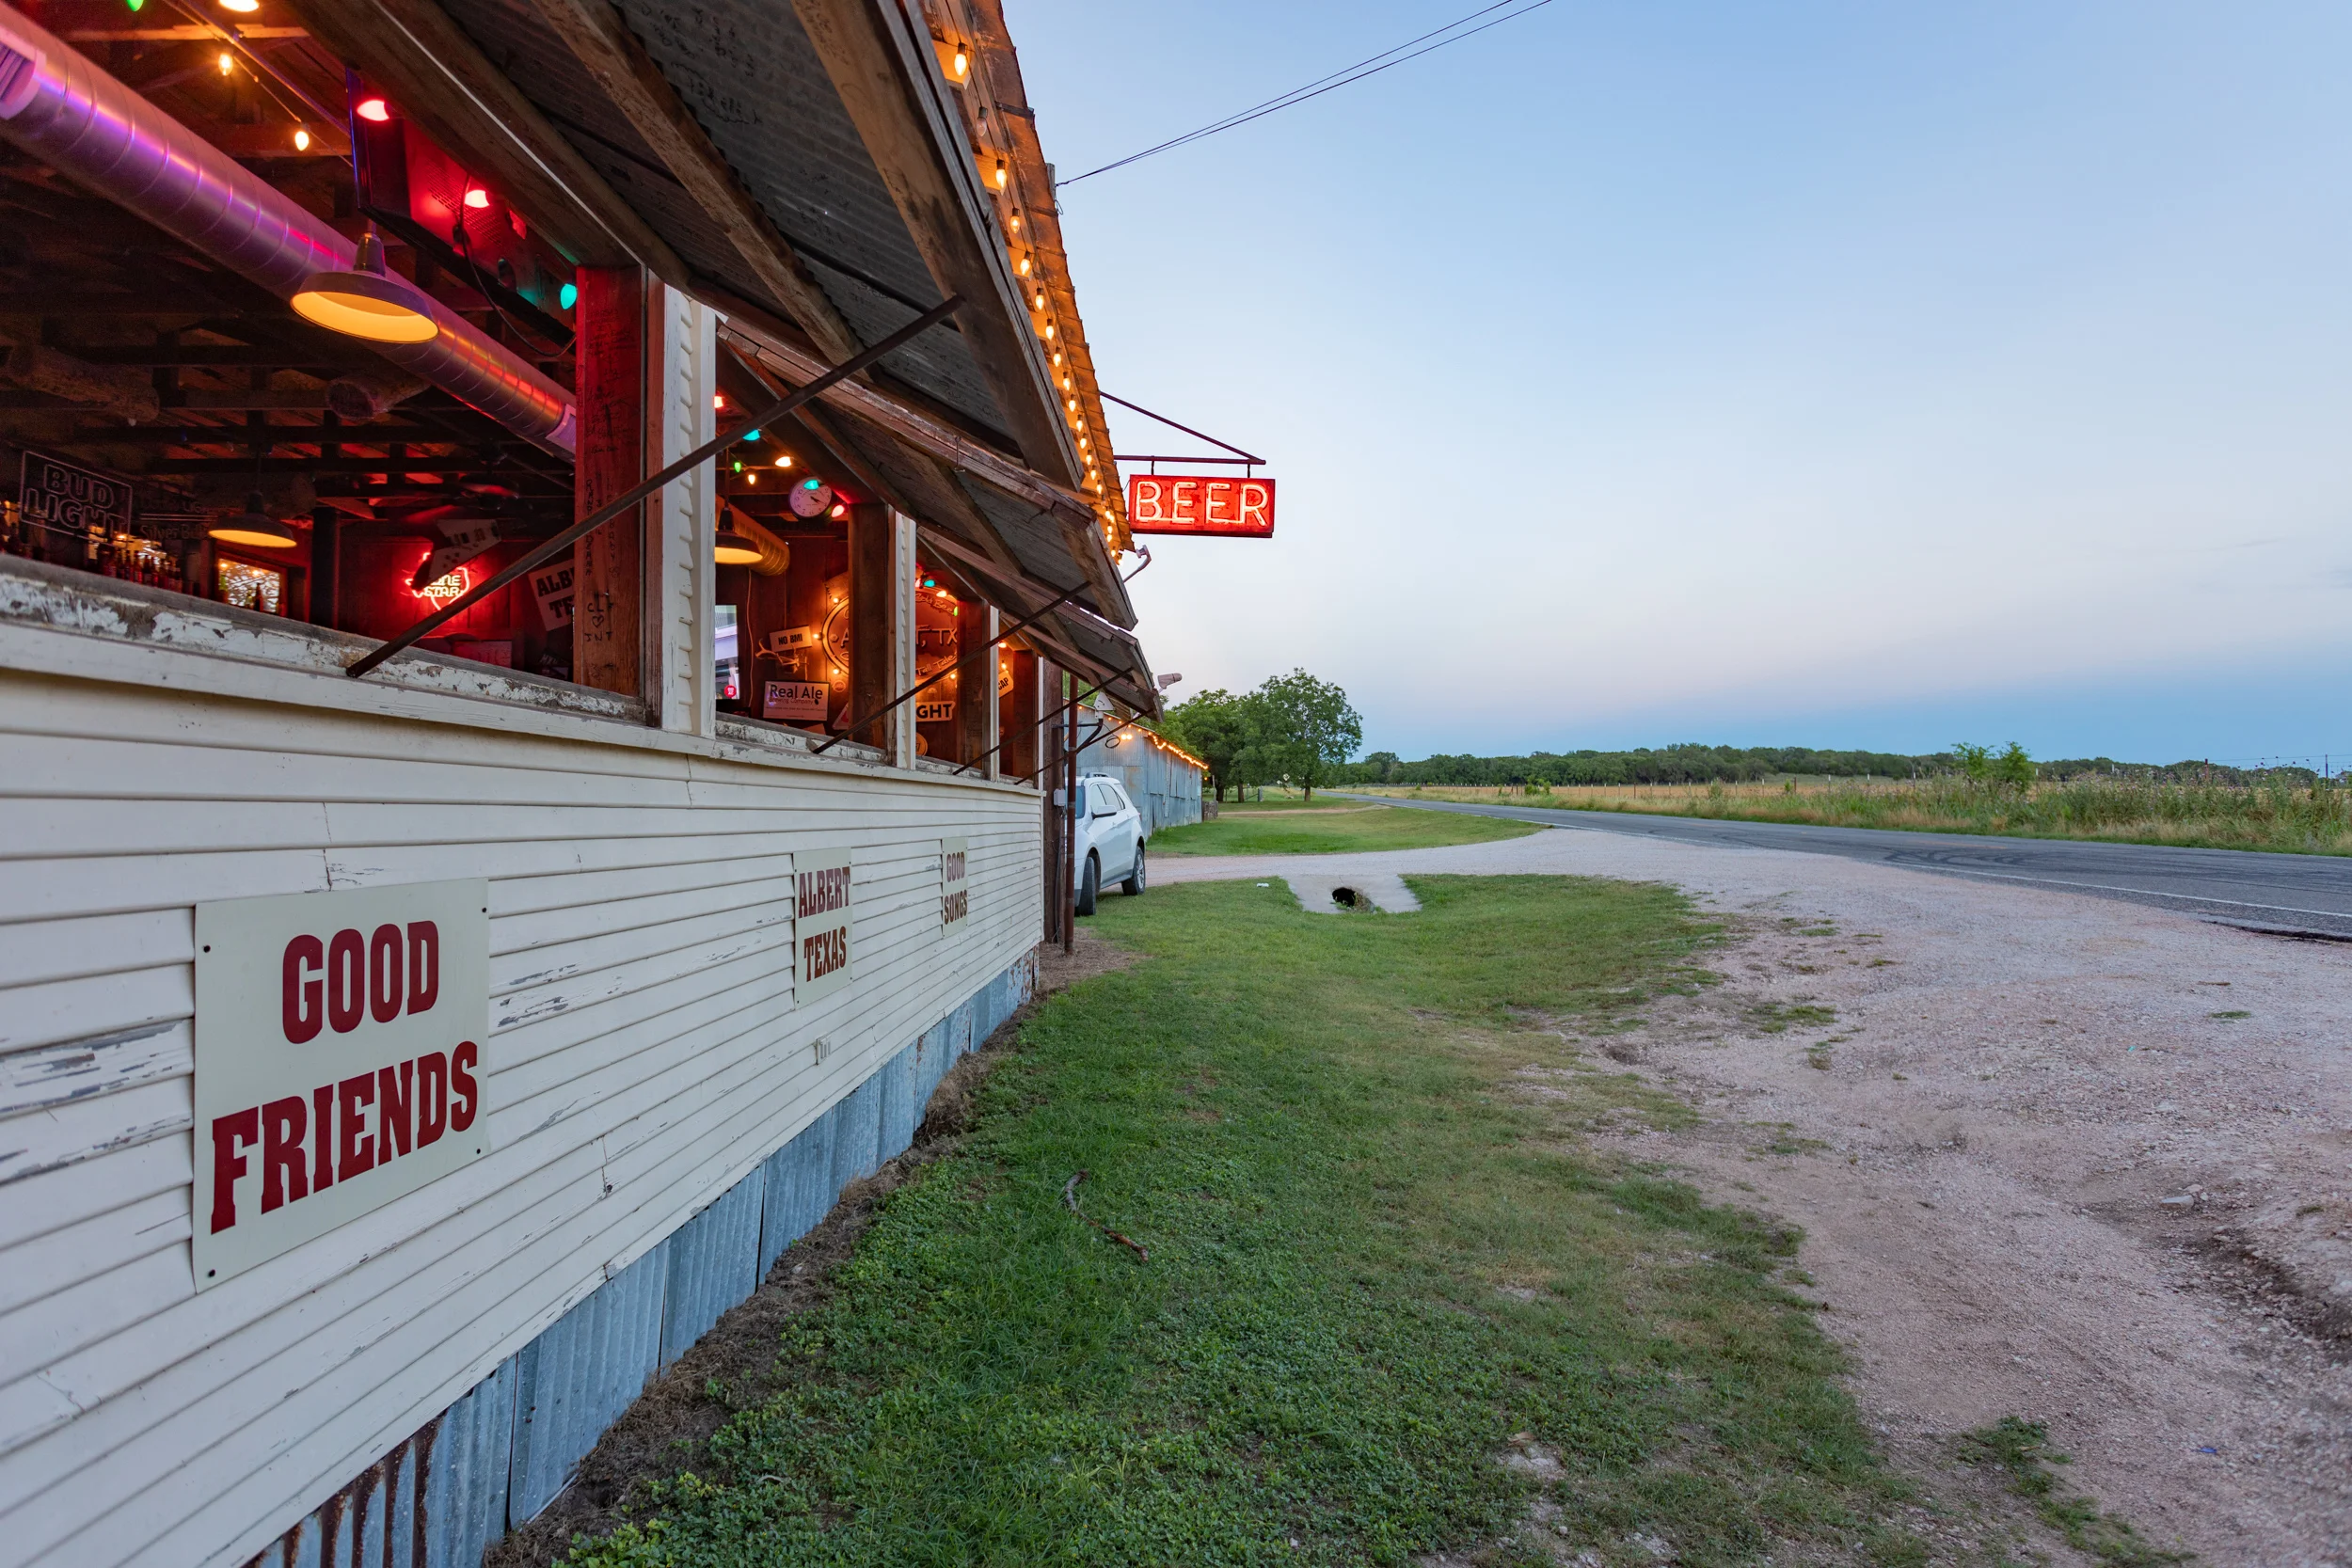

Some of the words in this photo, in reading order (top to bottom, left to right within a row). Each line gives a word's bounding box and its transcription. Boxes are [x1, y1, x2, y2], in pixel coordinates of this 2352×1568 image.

[43, 462, 115, 509] BUD
[1135, 481, 1269, 528] BEER
[24, 487, 126, 542] LIGHT
[423, 585, 460, 597] STAR
[535, 567, 575, 597] ALB
[778, 636, 788, 646] NO
[789, 633, 803, 643] BMI
[932, 628, 958, 646] TX
[770, 684, 798, 699] Real
[802, 686, 823, 700] Ale
[946, 851, 966, 883] GOOD
[798, 865, 851, 920] ALBERT
[944, 890, 969, 926] SONGS
[803, 926, 847, 983] TEXAS
[282, 920, 439, 1045] GOOD
[210, 1040, 478, 1236] FRIENDS
